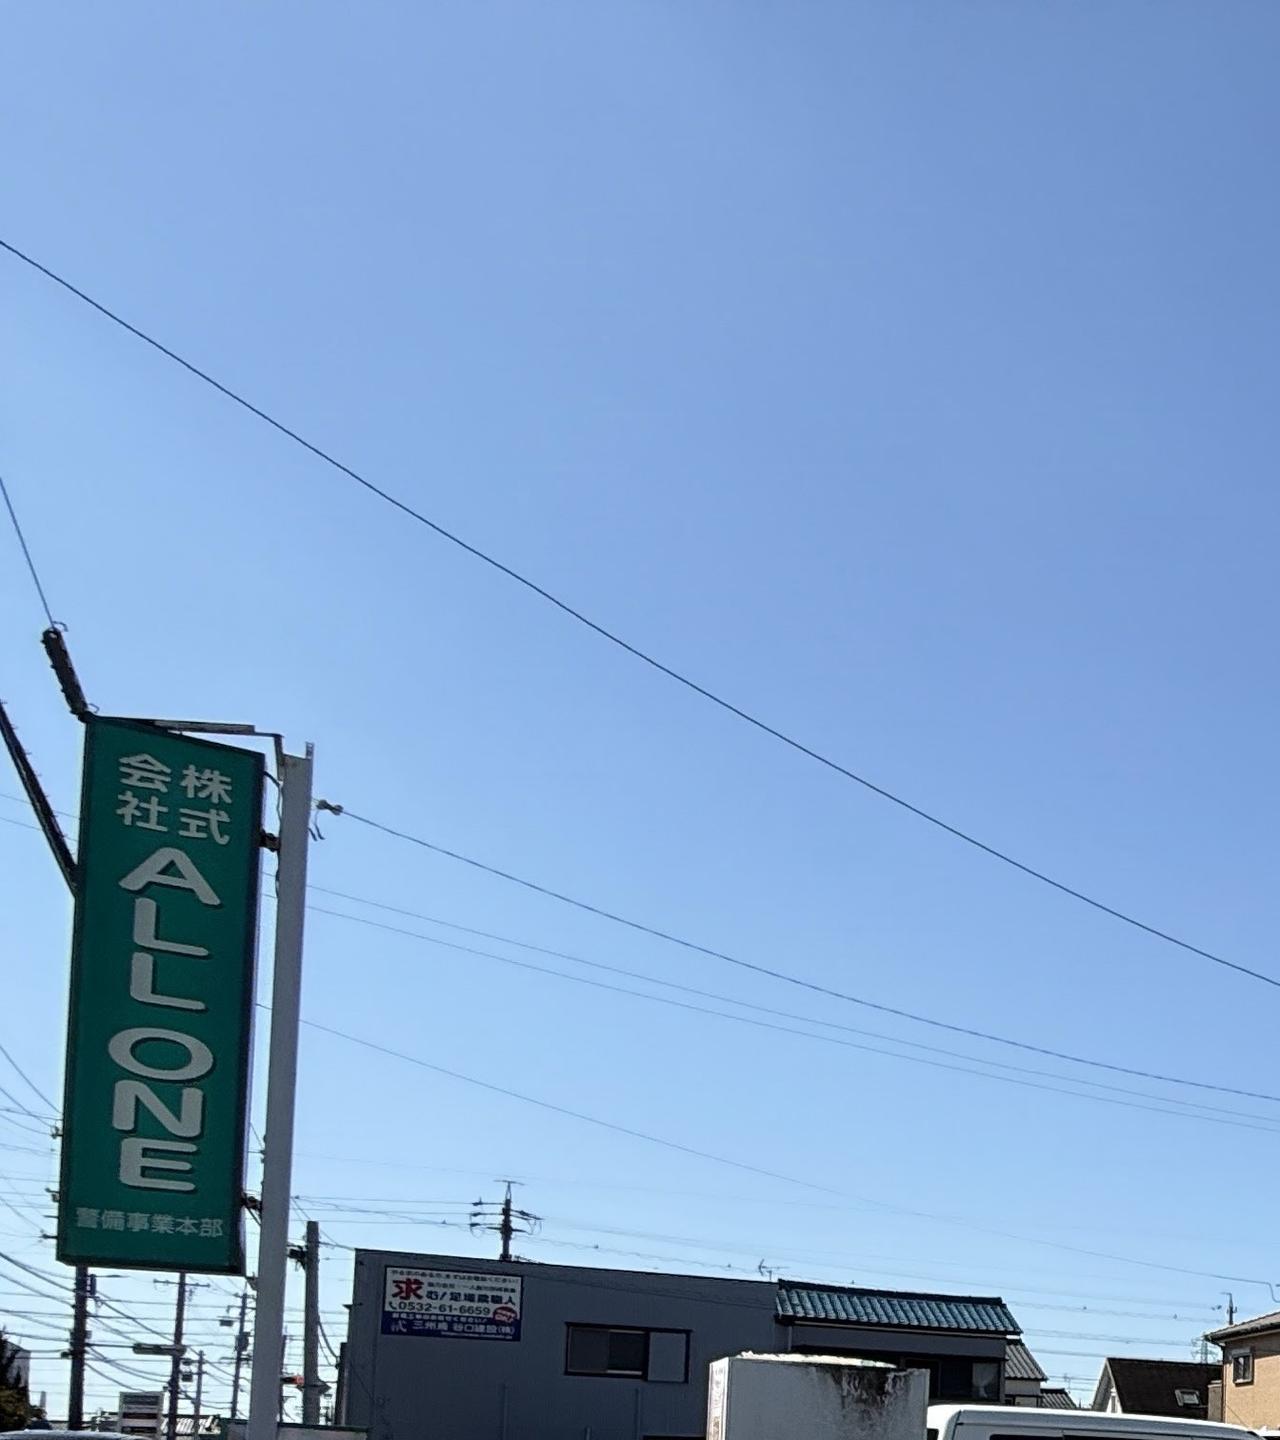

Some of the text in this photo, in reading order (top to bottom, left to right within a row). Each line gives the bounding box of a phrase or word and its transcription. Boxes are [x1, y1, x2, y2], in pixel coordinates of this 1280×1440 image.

[75, 1207, 224, 1238] 警備事業本部
[399, 1302, 491, 1316] 0532-61-6659
